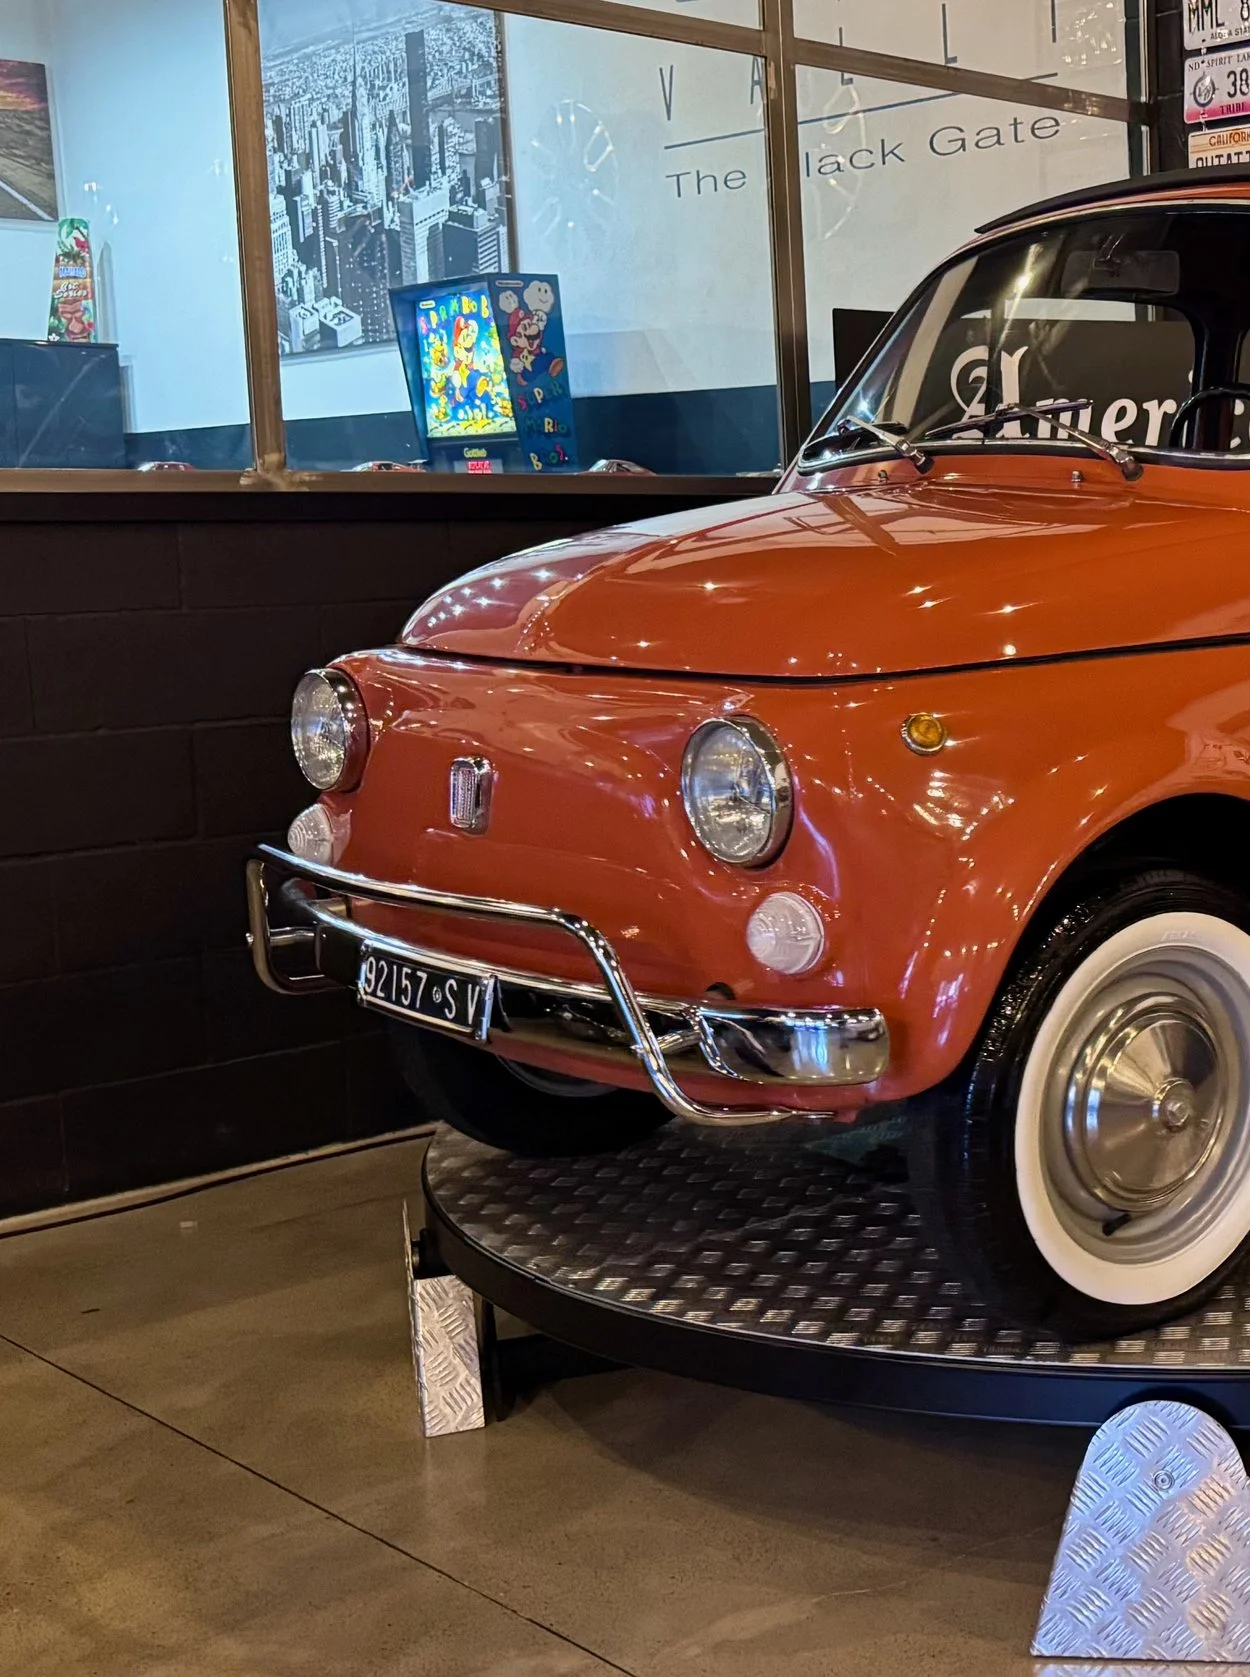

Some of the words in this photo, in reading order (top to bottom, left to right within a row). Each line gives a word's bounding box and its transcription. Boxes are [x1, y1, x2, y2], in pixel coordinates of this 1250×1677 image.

[1188, 61, 1201, 71] ND
[1205, 55, 1233, 68] SPIRIT
[665, 168, 747, 199] The
[804, 138, 906, 179] lack
[928, 115, 1062, 158] Gate
[365, 956, 428, 1009] 92157
